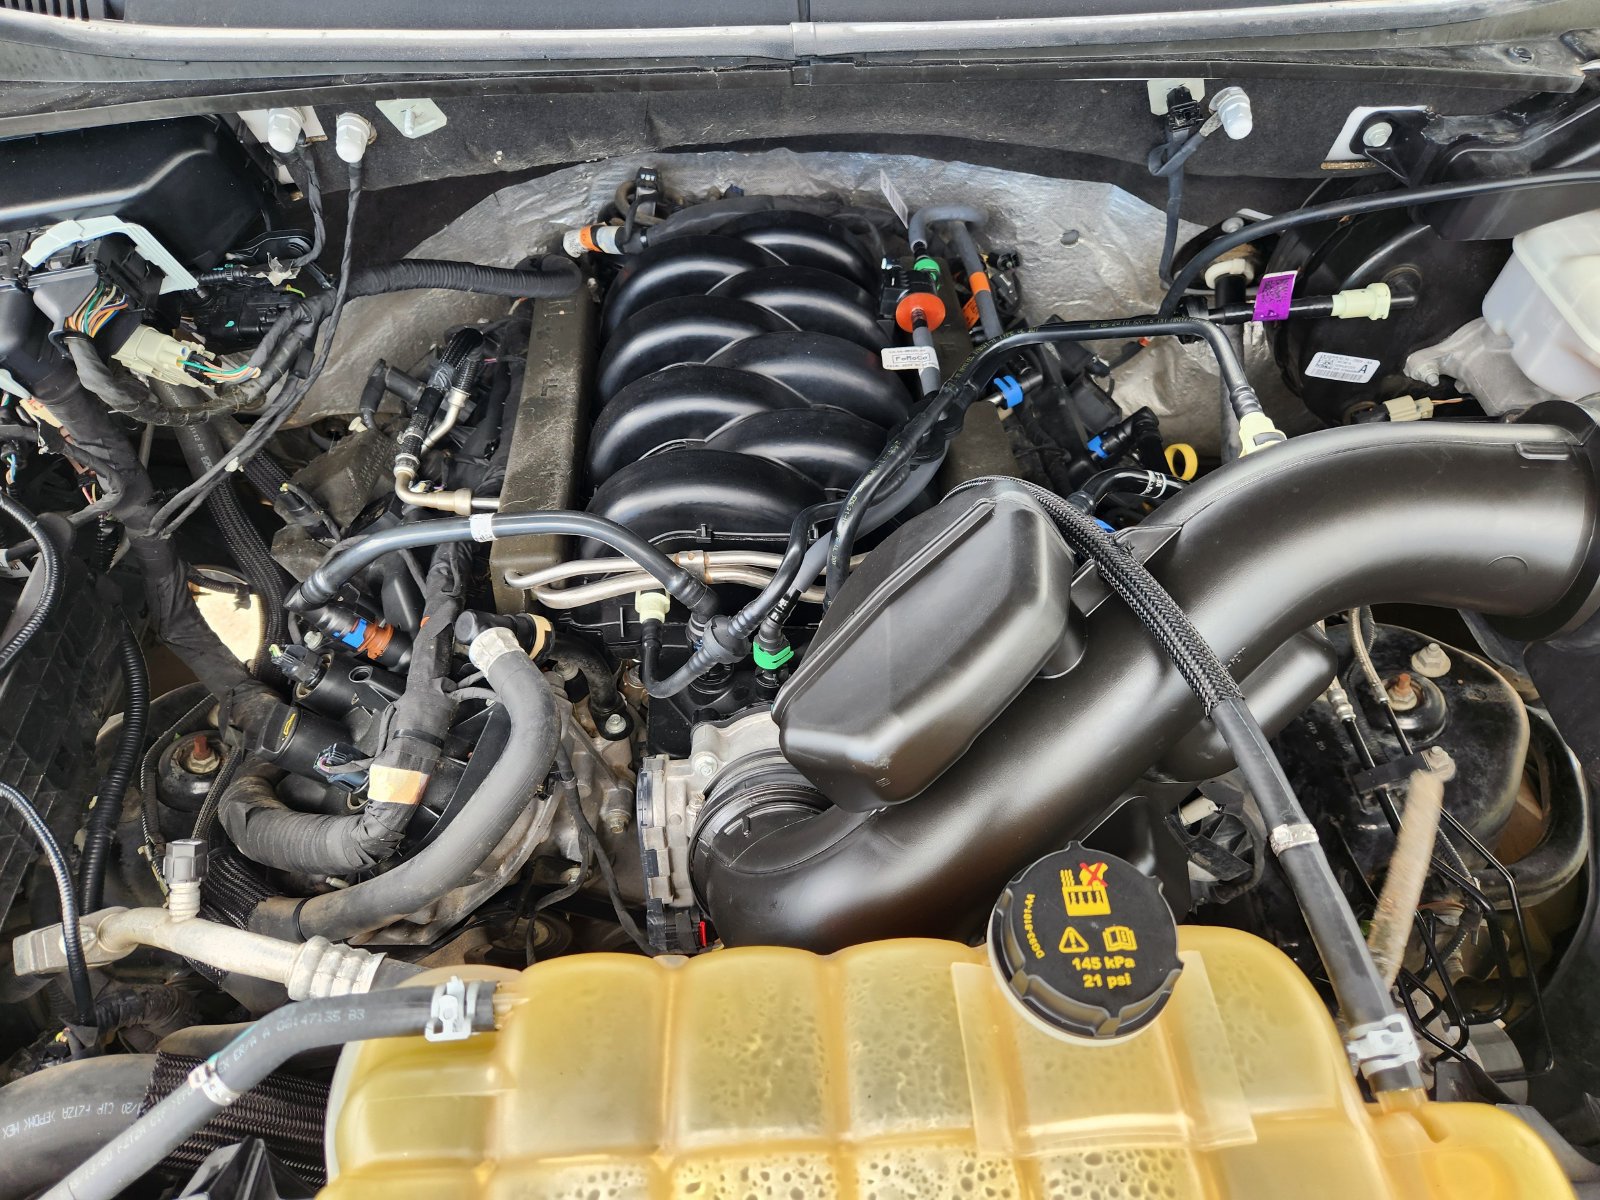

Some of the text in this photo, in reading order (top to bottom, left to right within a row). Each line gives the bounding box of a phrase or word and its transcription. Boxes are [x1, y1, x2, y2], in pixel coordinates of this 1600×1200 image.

[1358, 364, 1368, 374] A
[1072, 956, 1136, 971] 145 kPa
[1082, 972, 1132, 989] 21 psi
